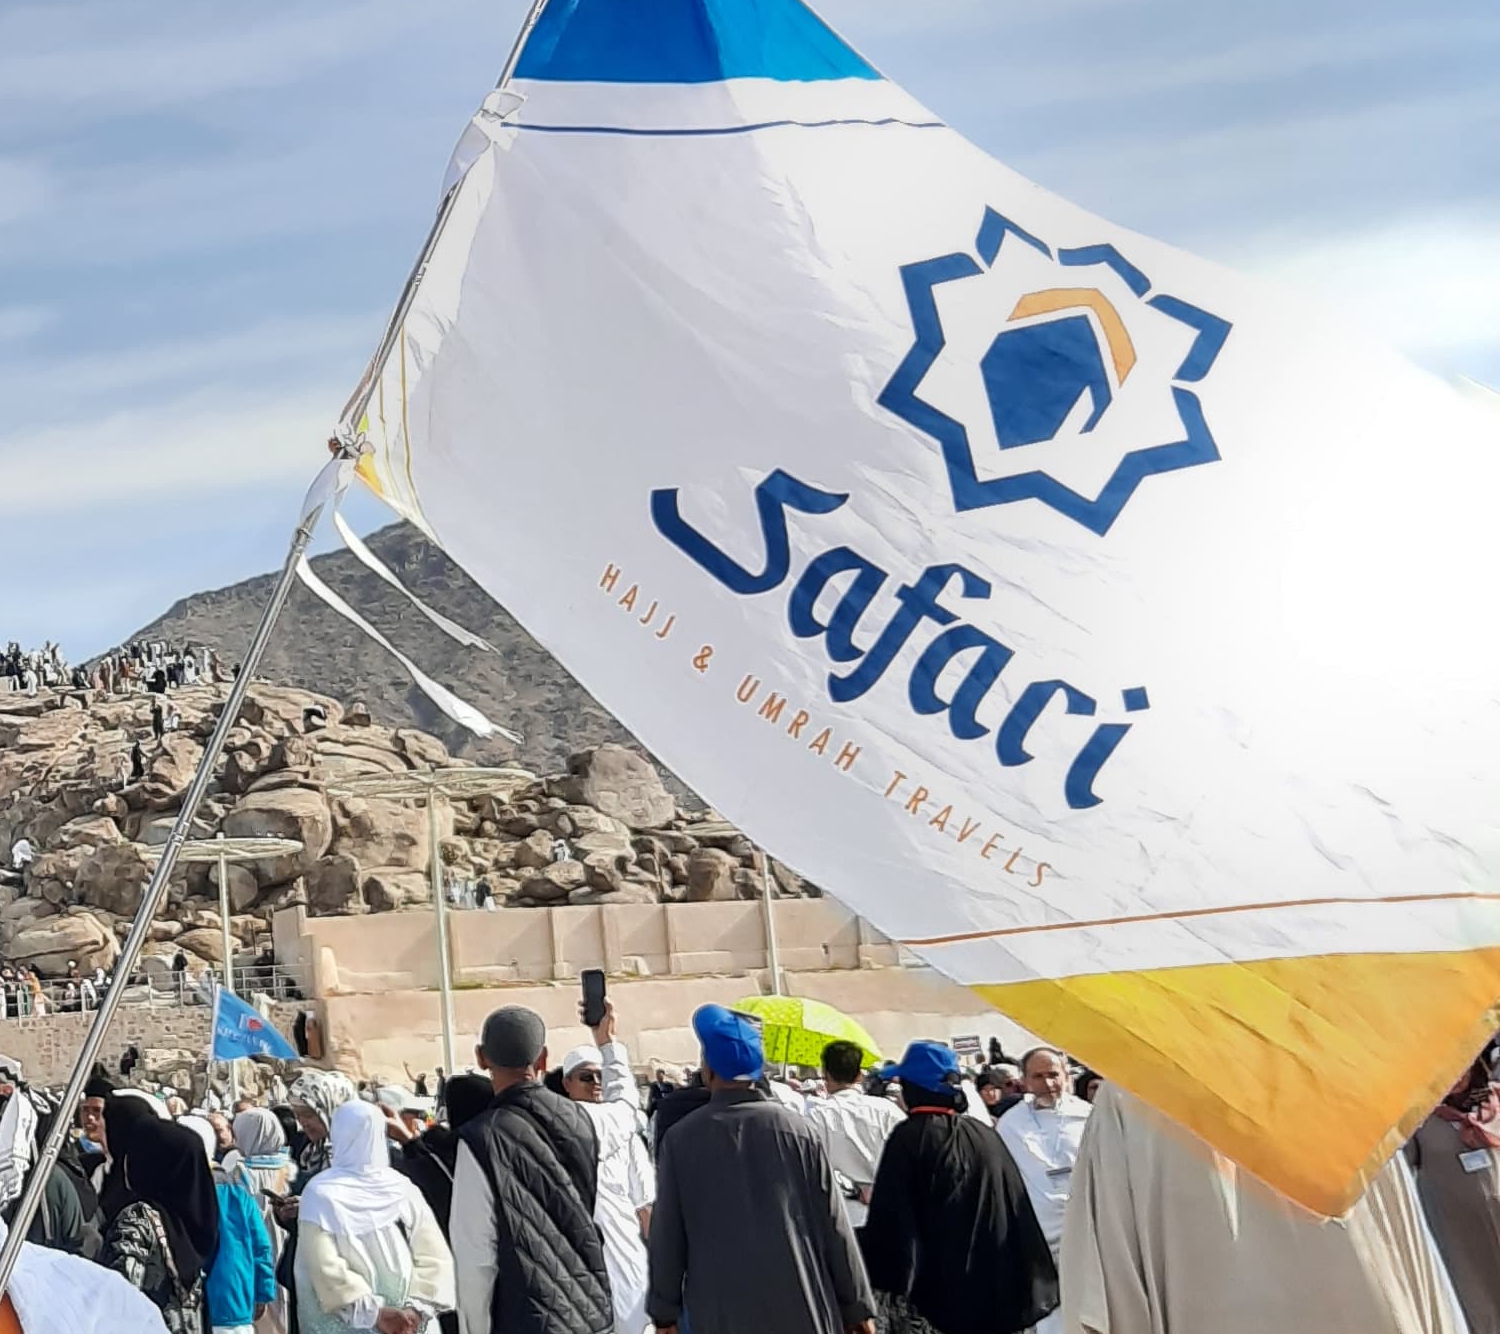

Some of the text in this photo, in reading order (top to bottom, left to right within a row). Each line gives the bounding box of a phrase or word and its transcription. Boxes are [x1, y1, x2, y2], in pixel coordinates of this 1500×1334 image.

[599, 563, 1054, 890] HAJJ & UMRAH TRAVELS
[650, 467, 1150, 810] Safari
